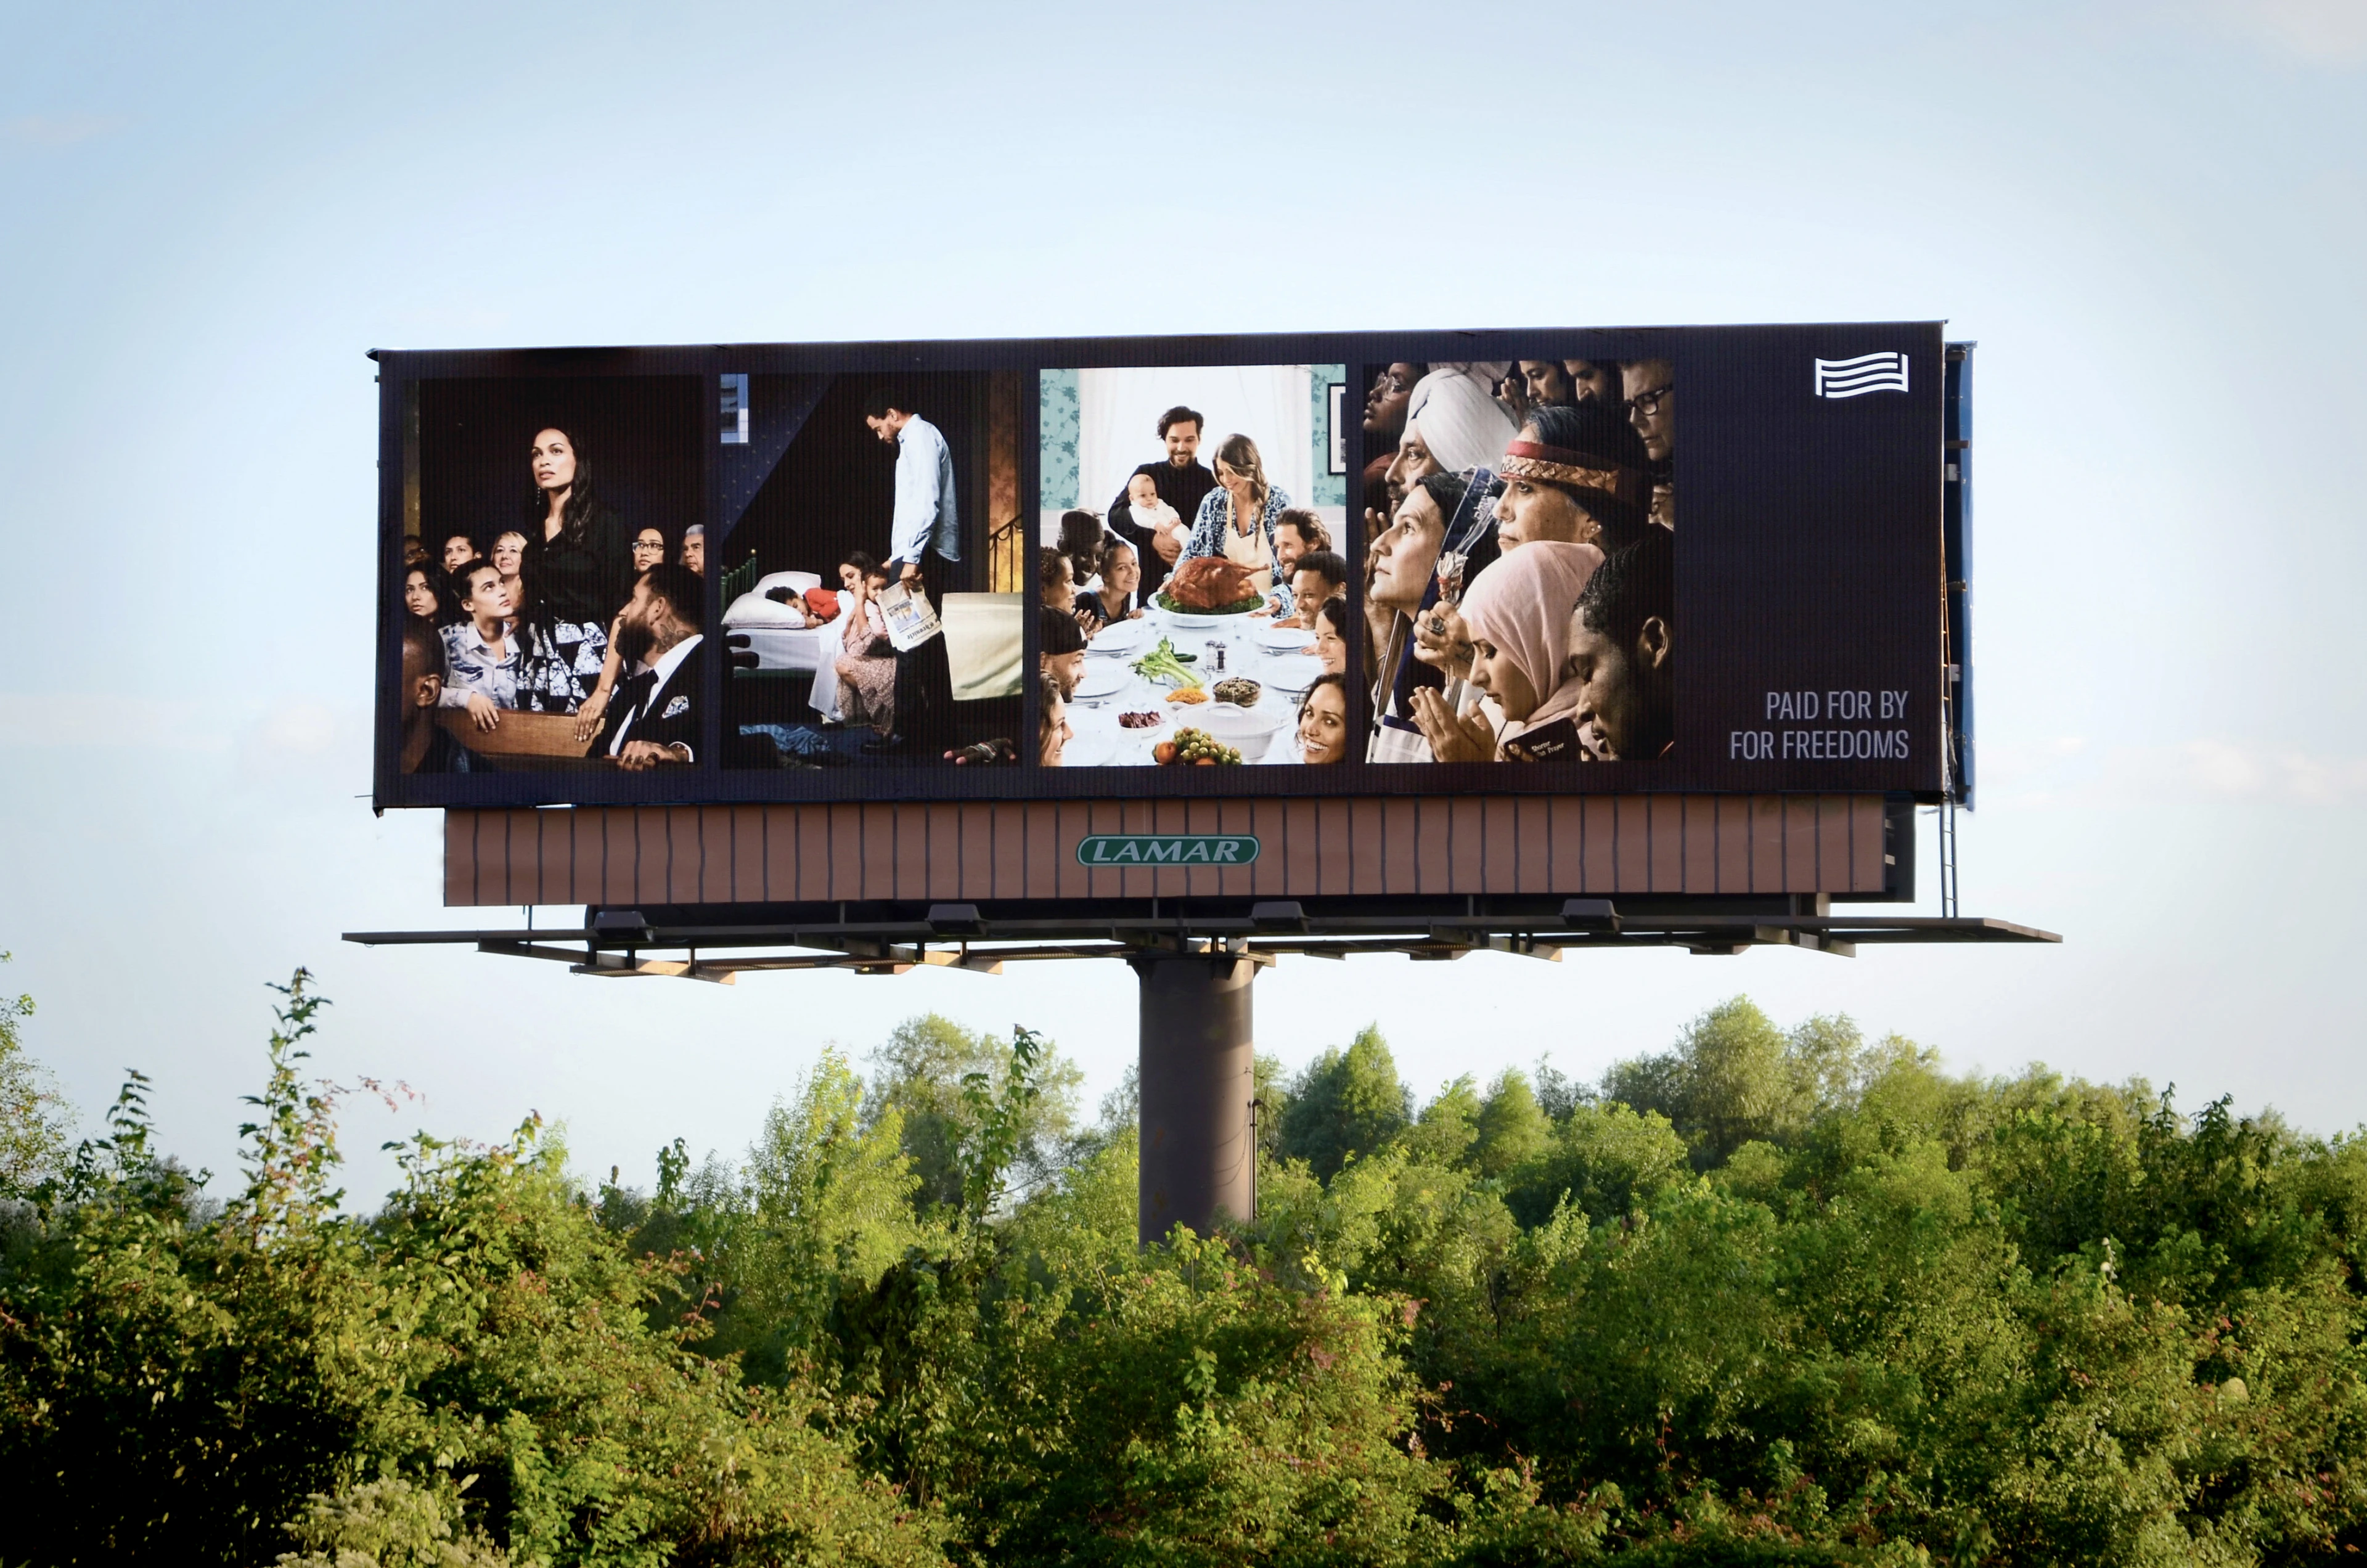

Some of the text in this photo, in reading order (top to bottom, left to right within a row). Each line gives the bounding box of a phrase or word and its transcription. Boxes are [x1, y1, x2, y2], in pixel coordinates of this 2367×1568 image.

[907, 621, 934, 639] Chronicle
[1767, 690, 1909, 719] PAID FOR BY
[1531, 741, 1550, 752] Shorter
[1547, 743, 1564, 753] Prayer
[1730, 730, 1909, 759] FOR FREEDOMS
[1092, 841, 1240, 861] LAMAR
